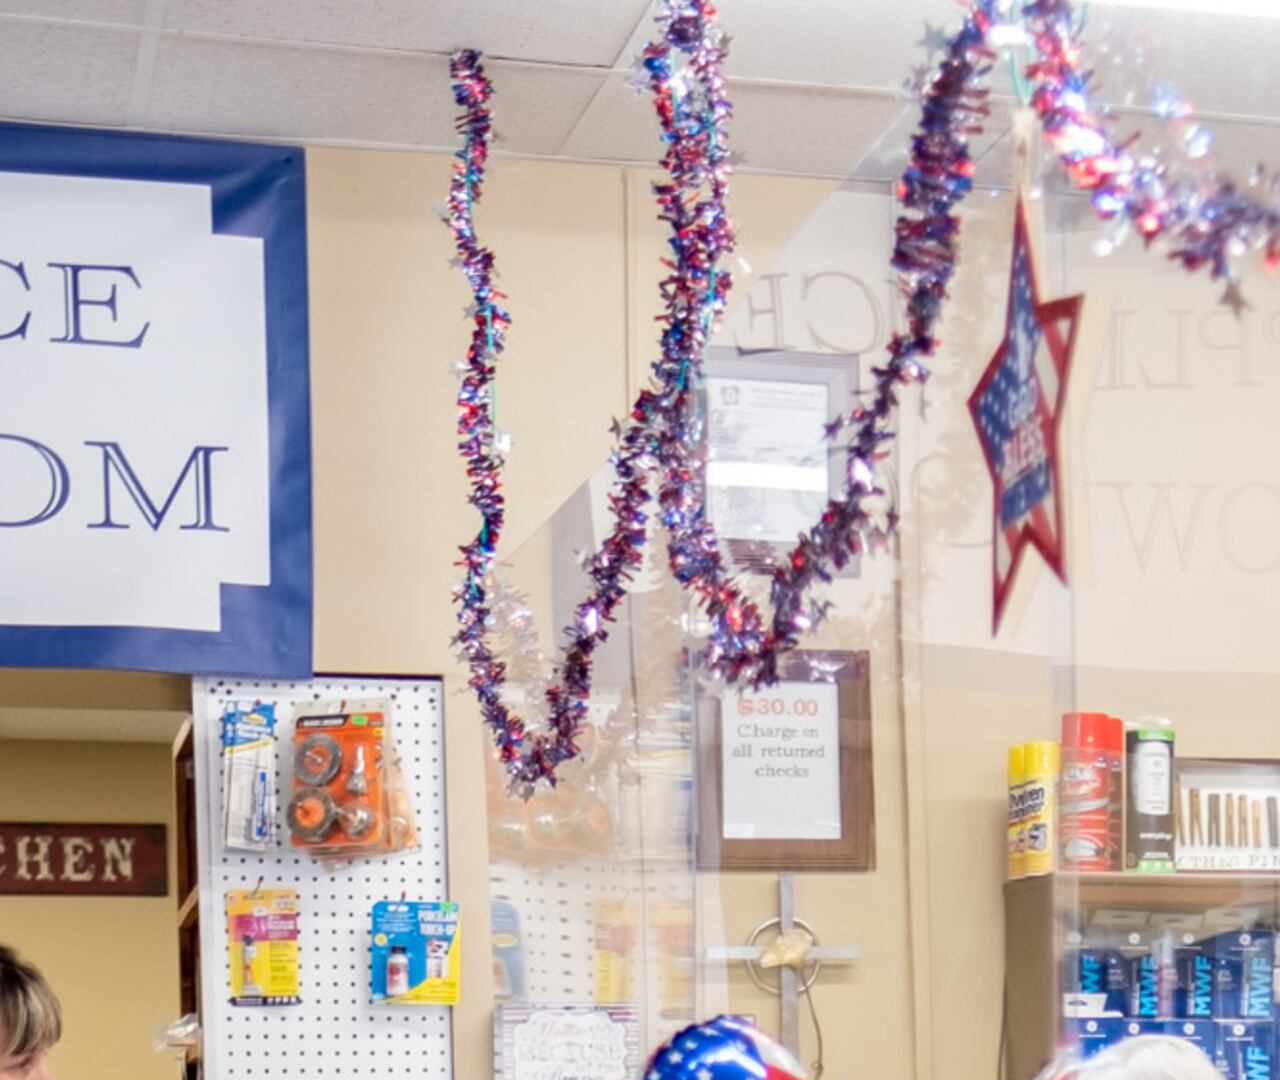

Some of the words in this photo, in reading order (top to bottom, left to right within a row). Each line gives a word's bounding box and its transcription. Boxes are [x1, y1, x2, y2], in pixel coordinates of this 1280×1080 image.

[737, 698, 819, 717] $30.00
[737, 723, 798, 741] Charge
[732, 744, 753, 758] all
[760, 745, 825, 758] returned
[754, 764, 810, 778] checks
[1139, 955, 1159, 1016] MWF
[1194, 955, 1212, 1016] MWF
[1246, 957, 1271, 1017] MWF
